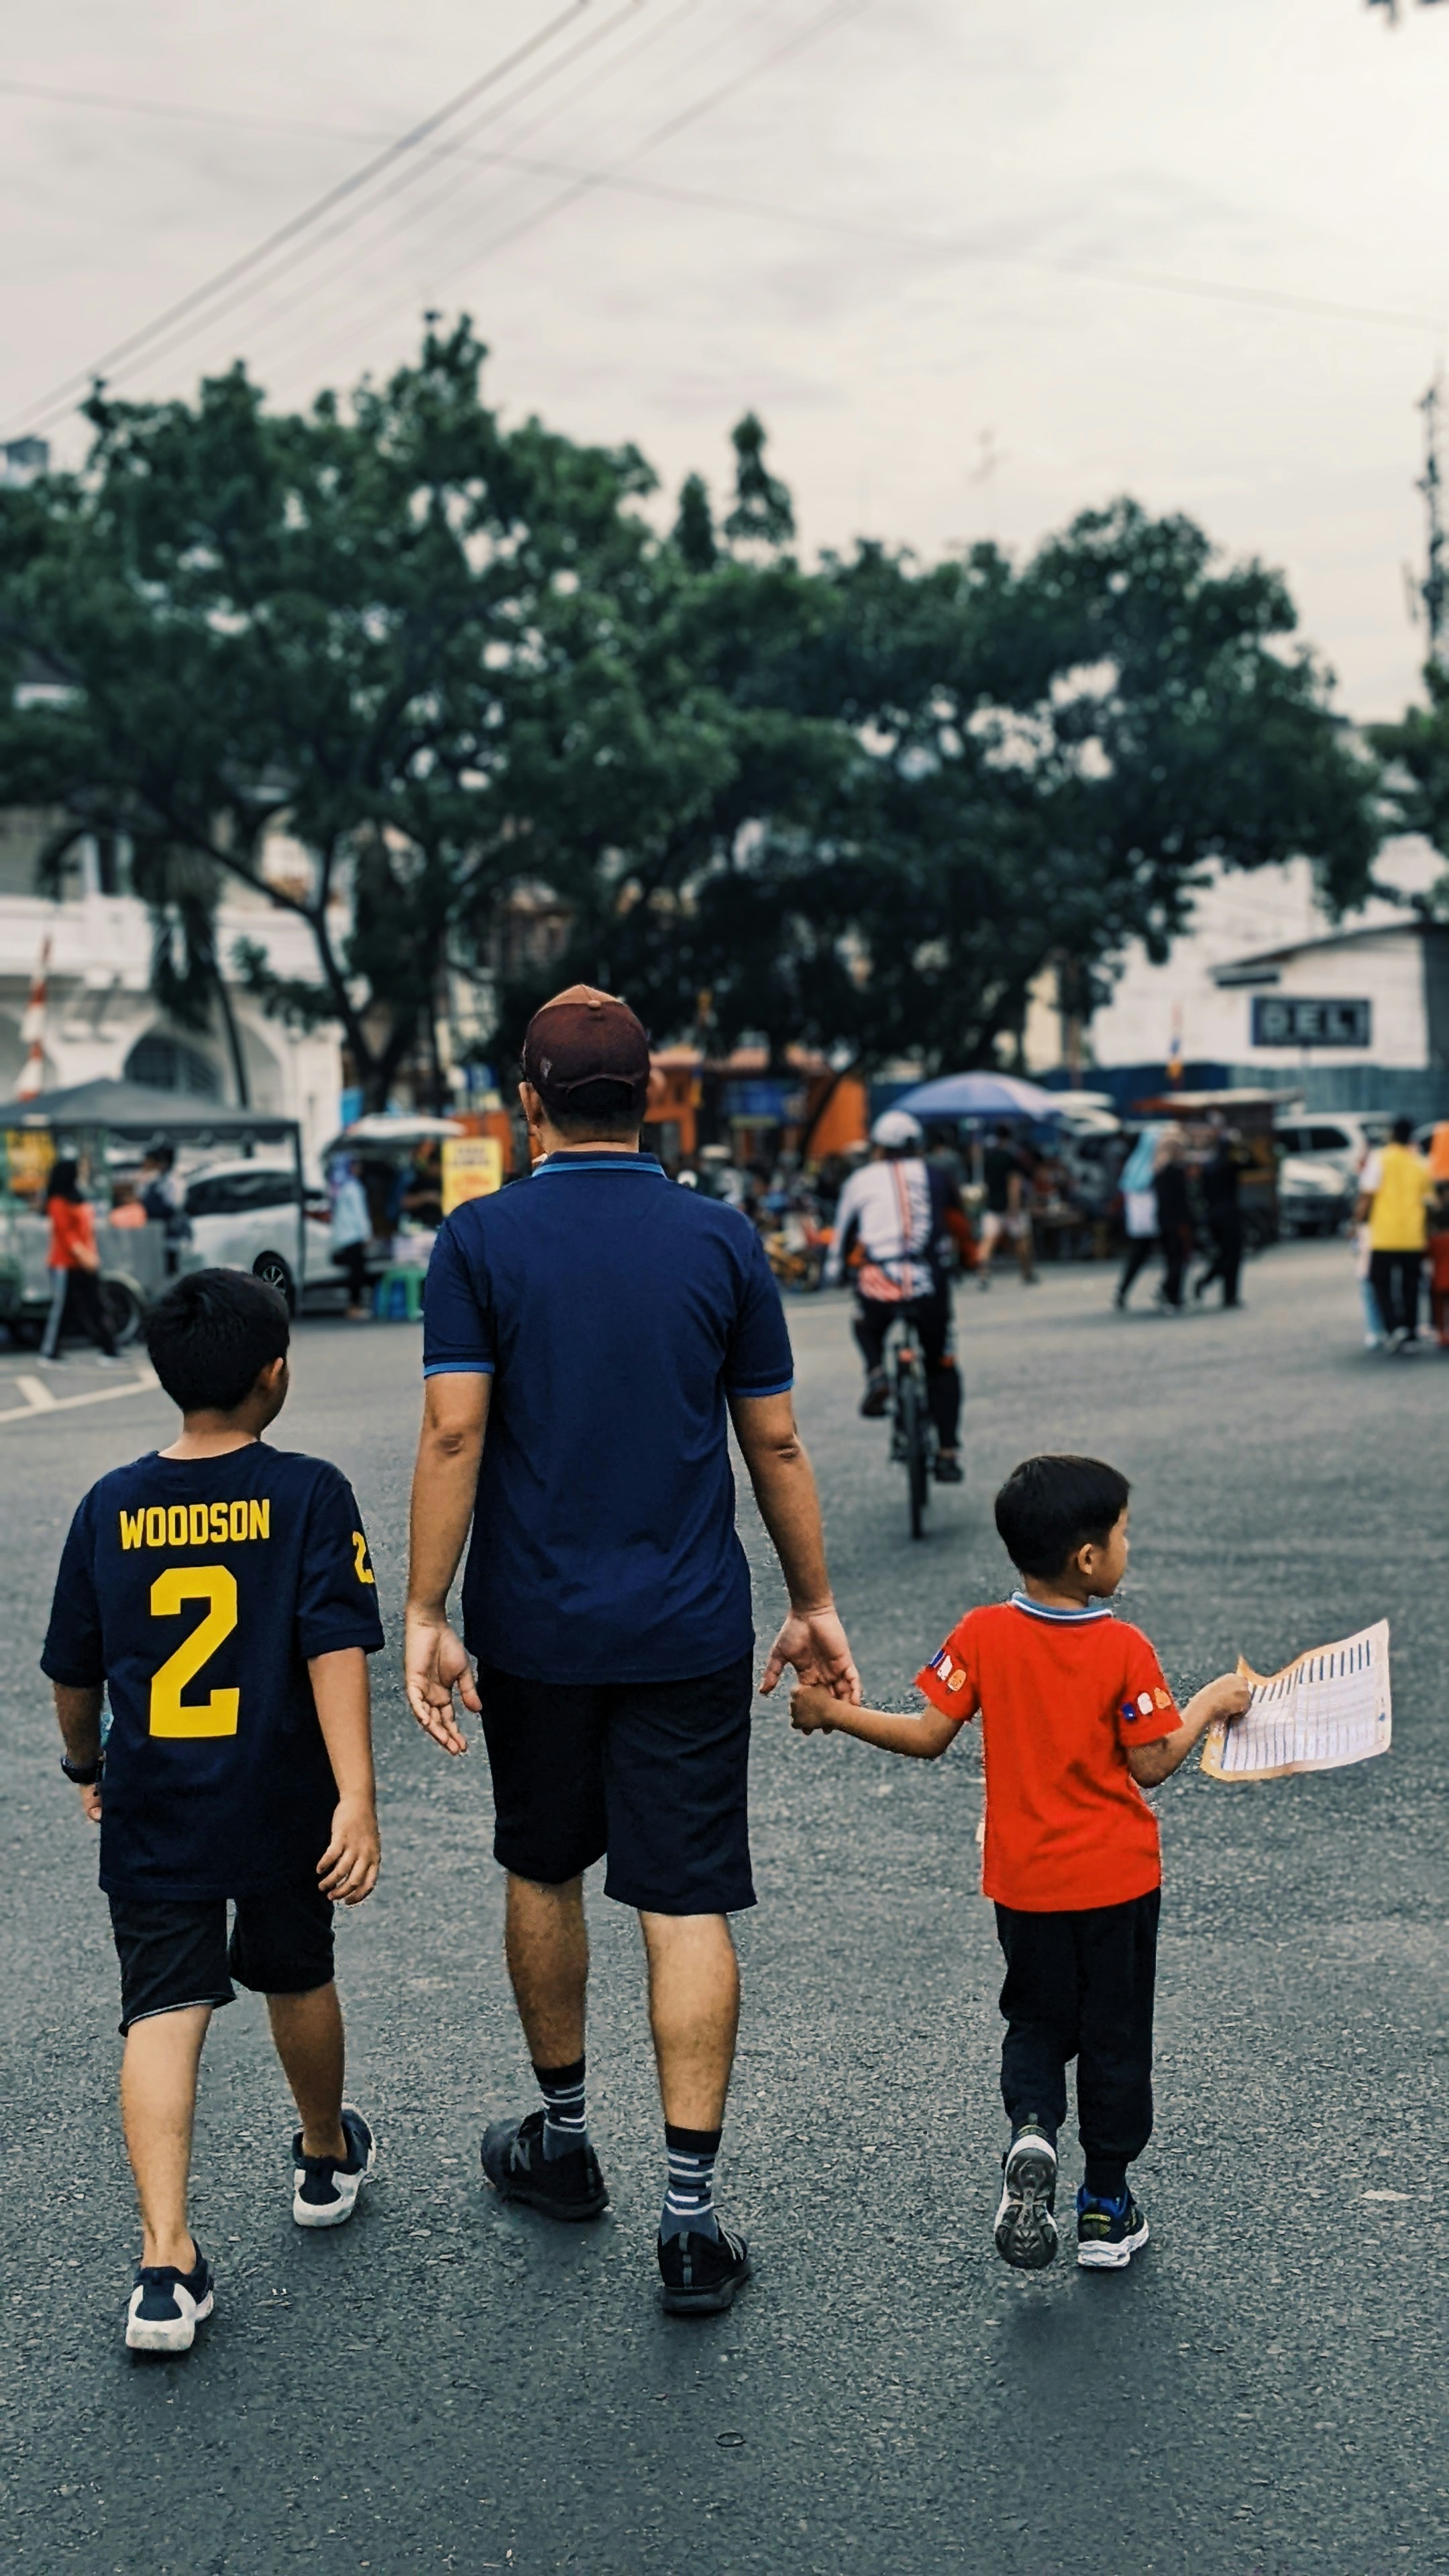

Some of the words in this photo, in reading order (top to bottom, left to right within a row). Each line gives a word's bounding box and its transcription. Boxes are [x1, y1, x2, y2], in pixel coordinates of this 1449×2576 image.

[120, 1499, 270, 1550] WOODSON
[352, 1531, 374, 1584] 2
[149, 1564, 240, 1738] 2
